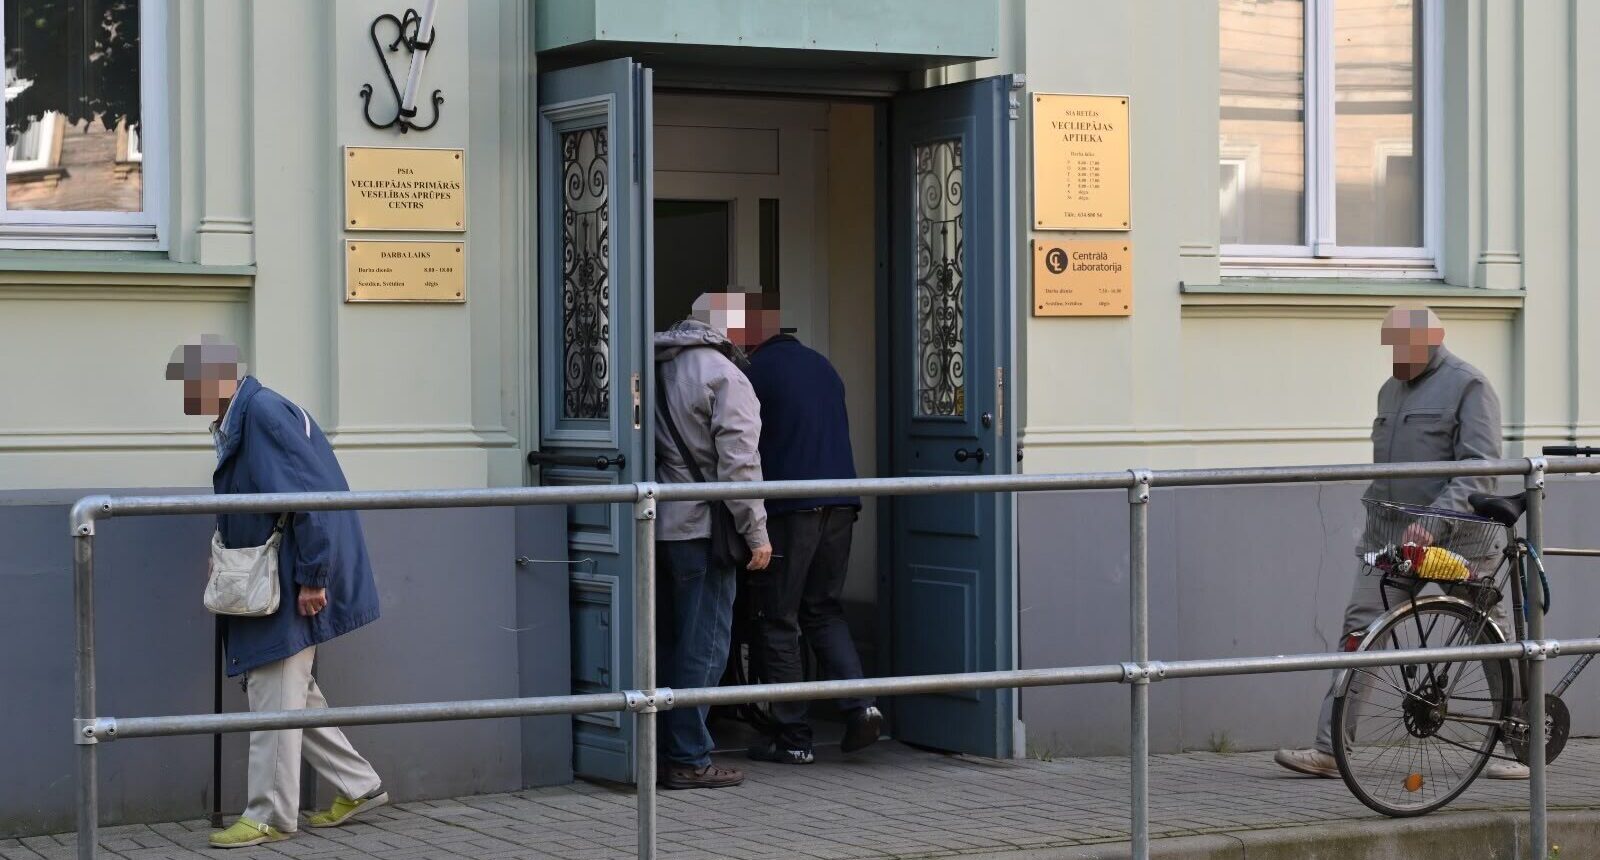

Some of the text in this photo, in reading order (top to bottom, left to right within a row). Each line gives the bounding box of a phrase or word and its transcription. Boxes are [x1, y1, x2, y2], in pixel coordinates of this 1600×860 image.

[1052, 120, 1114, 131] VECLIEPĀJAS
[1063, 134, 1103, 142] APTIEKA
[352, 180, 460, 190] VECLIEPĀJAS PRIMĀRĀS
[361, 190, 451, 199] VESELĪBAS APRŪPES
[1072, 252, 1108, 260] Centrālā
[1073, 262, 1122, 273] Laboratorija
